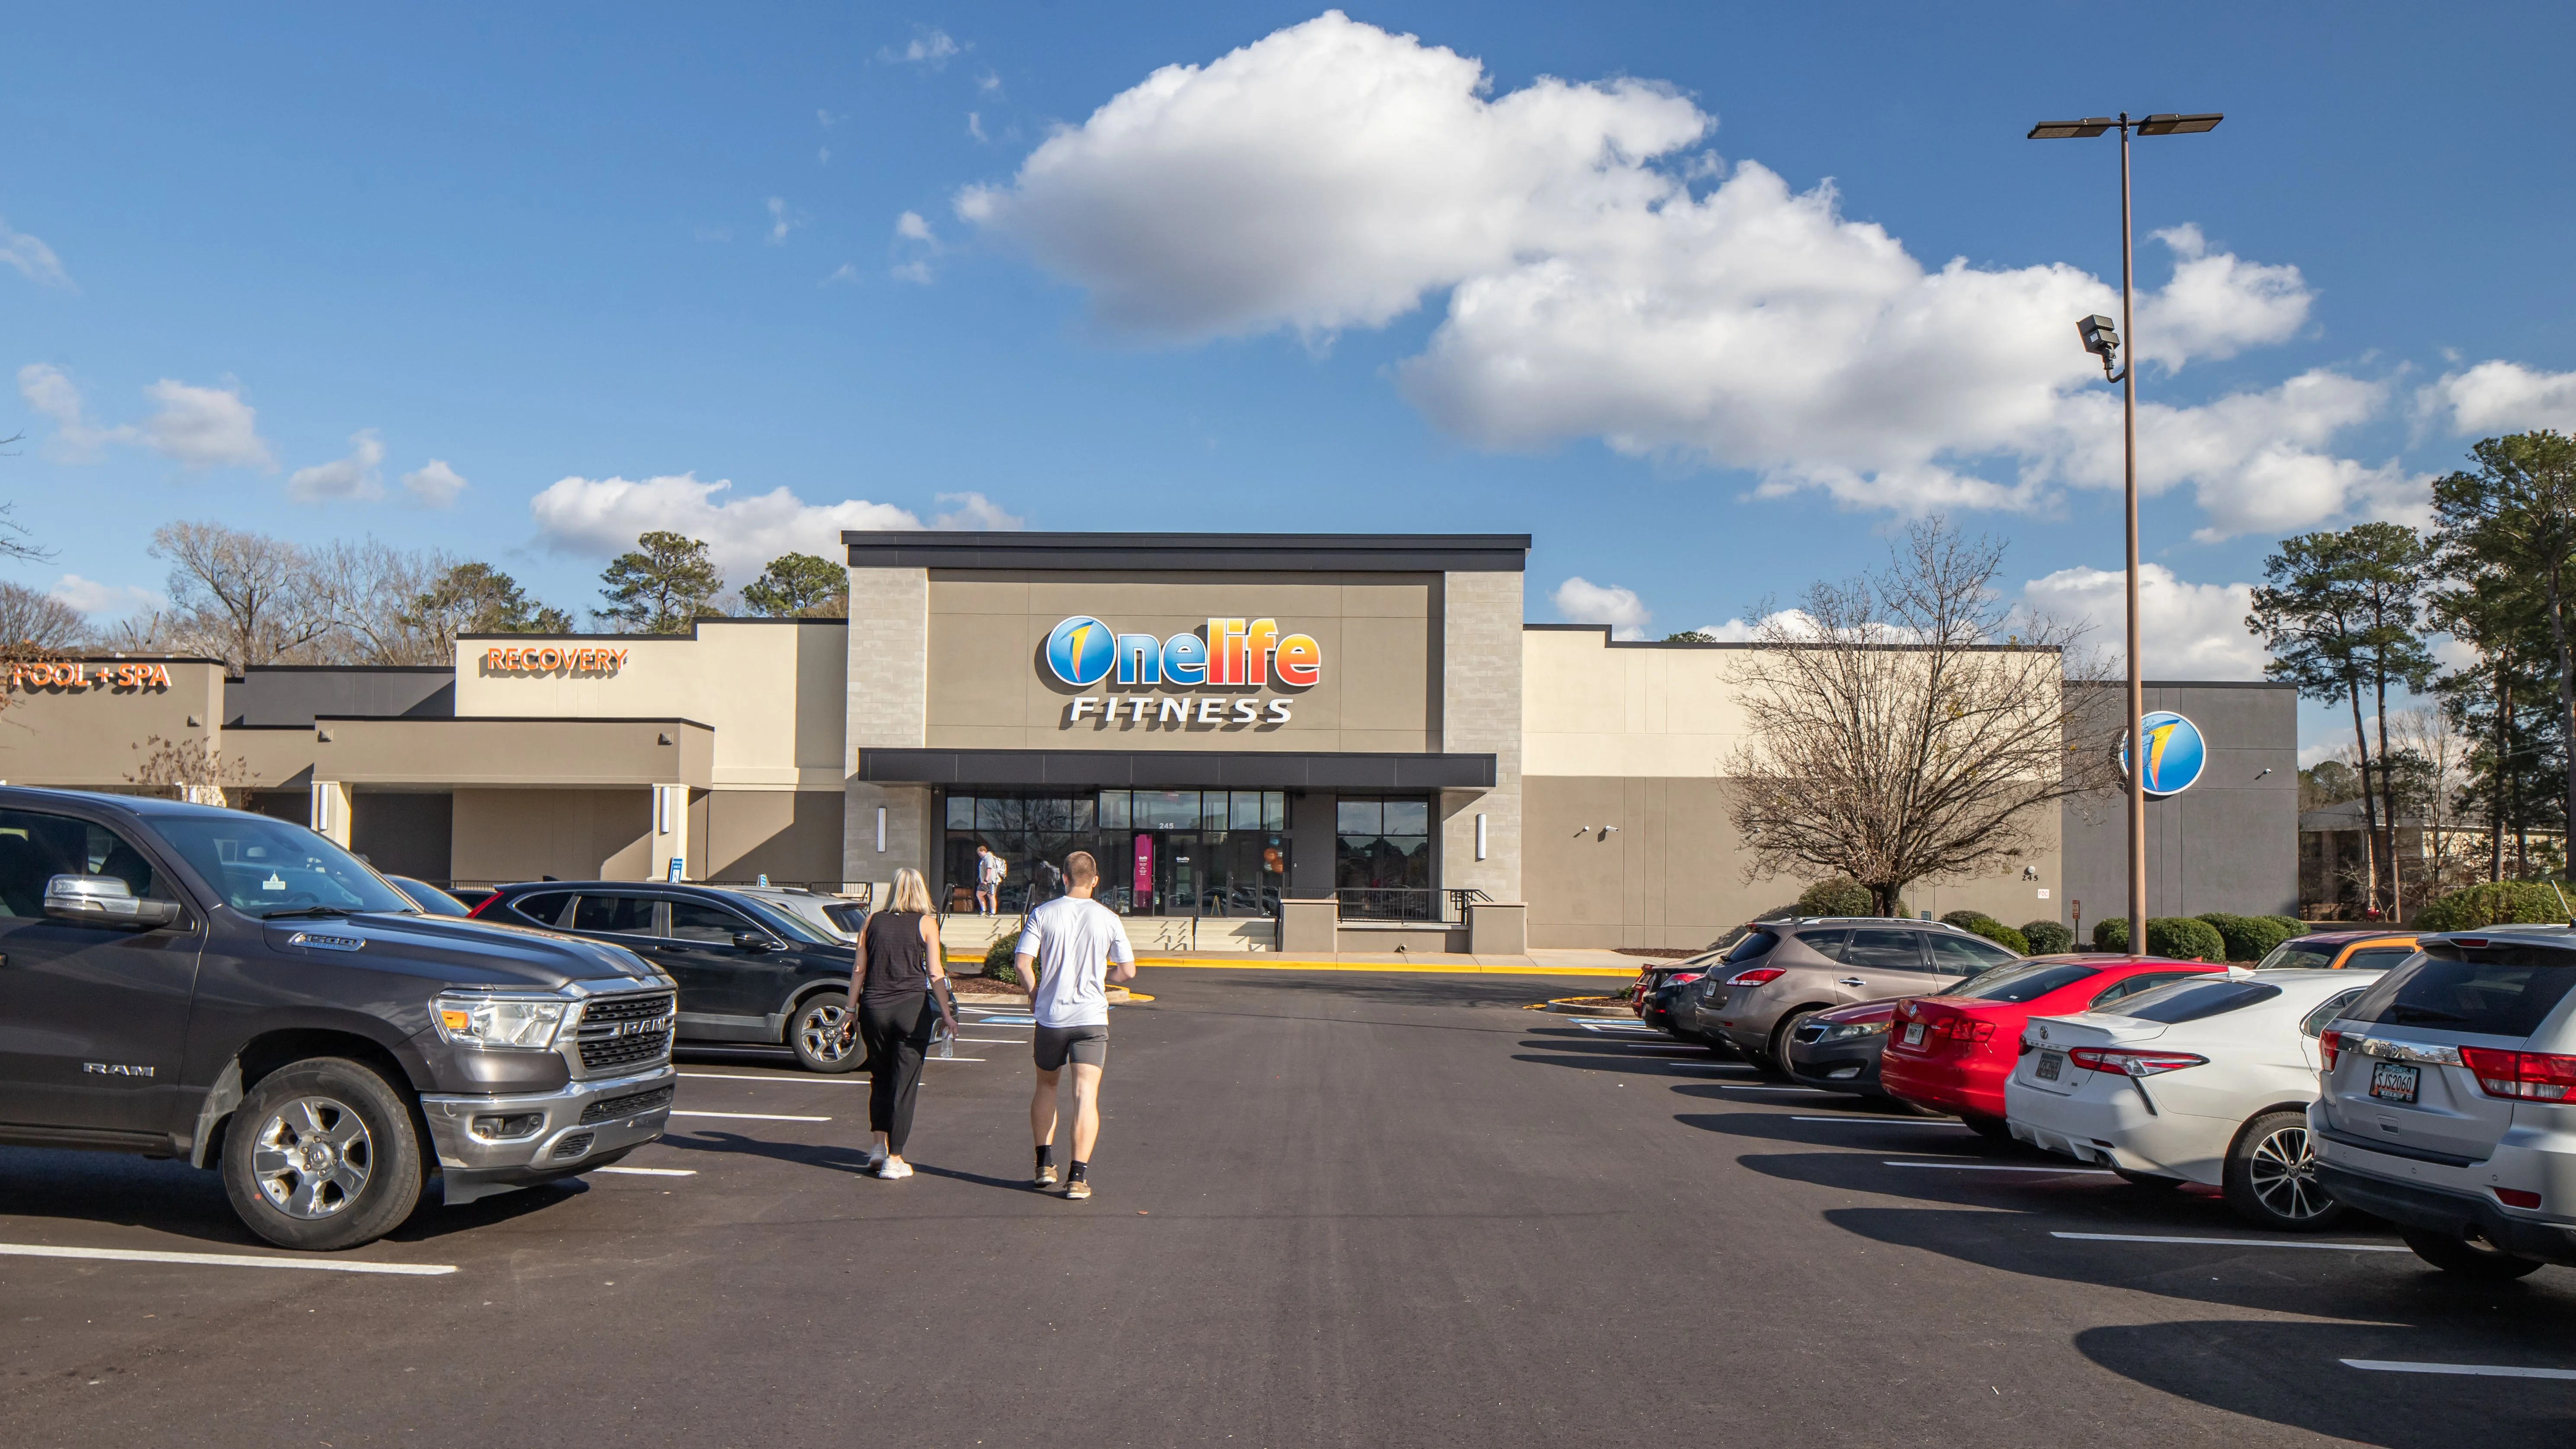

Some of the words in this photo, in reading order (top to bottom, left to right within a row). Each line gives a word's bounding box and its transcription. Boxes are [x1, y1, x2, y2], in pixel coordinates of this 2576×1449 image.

[488, 648, 629, 670] RECOVERY
[1047, 615, 1321, 686] Onelife
[13, 663, 91, 686] POOL
[118, 664, 172, 686] SPA
[1070, 697, 1294, 723] FITNESS
[307, 935, 355, 946] 1500
[623, 1018, 666, 1035] RAM
[2374, 1040, 2398, 1057] Jeep
[84, 1063, 154, 1077] RAM
[2392, 1067, 2415, 1075] GEORA
[2377, 1073, 2412, 1092] SJS2060
